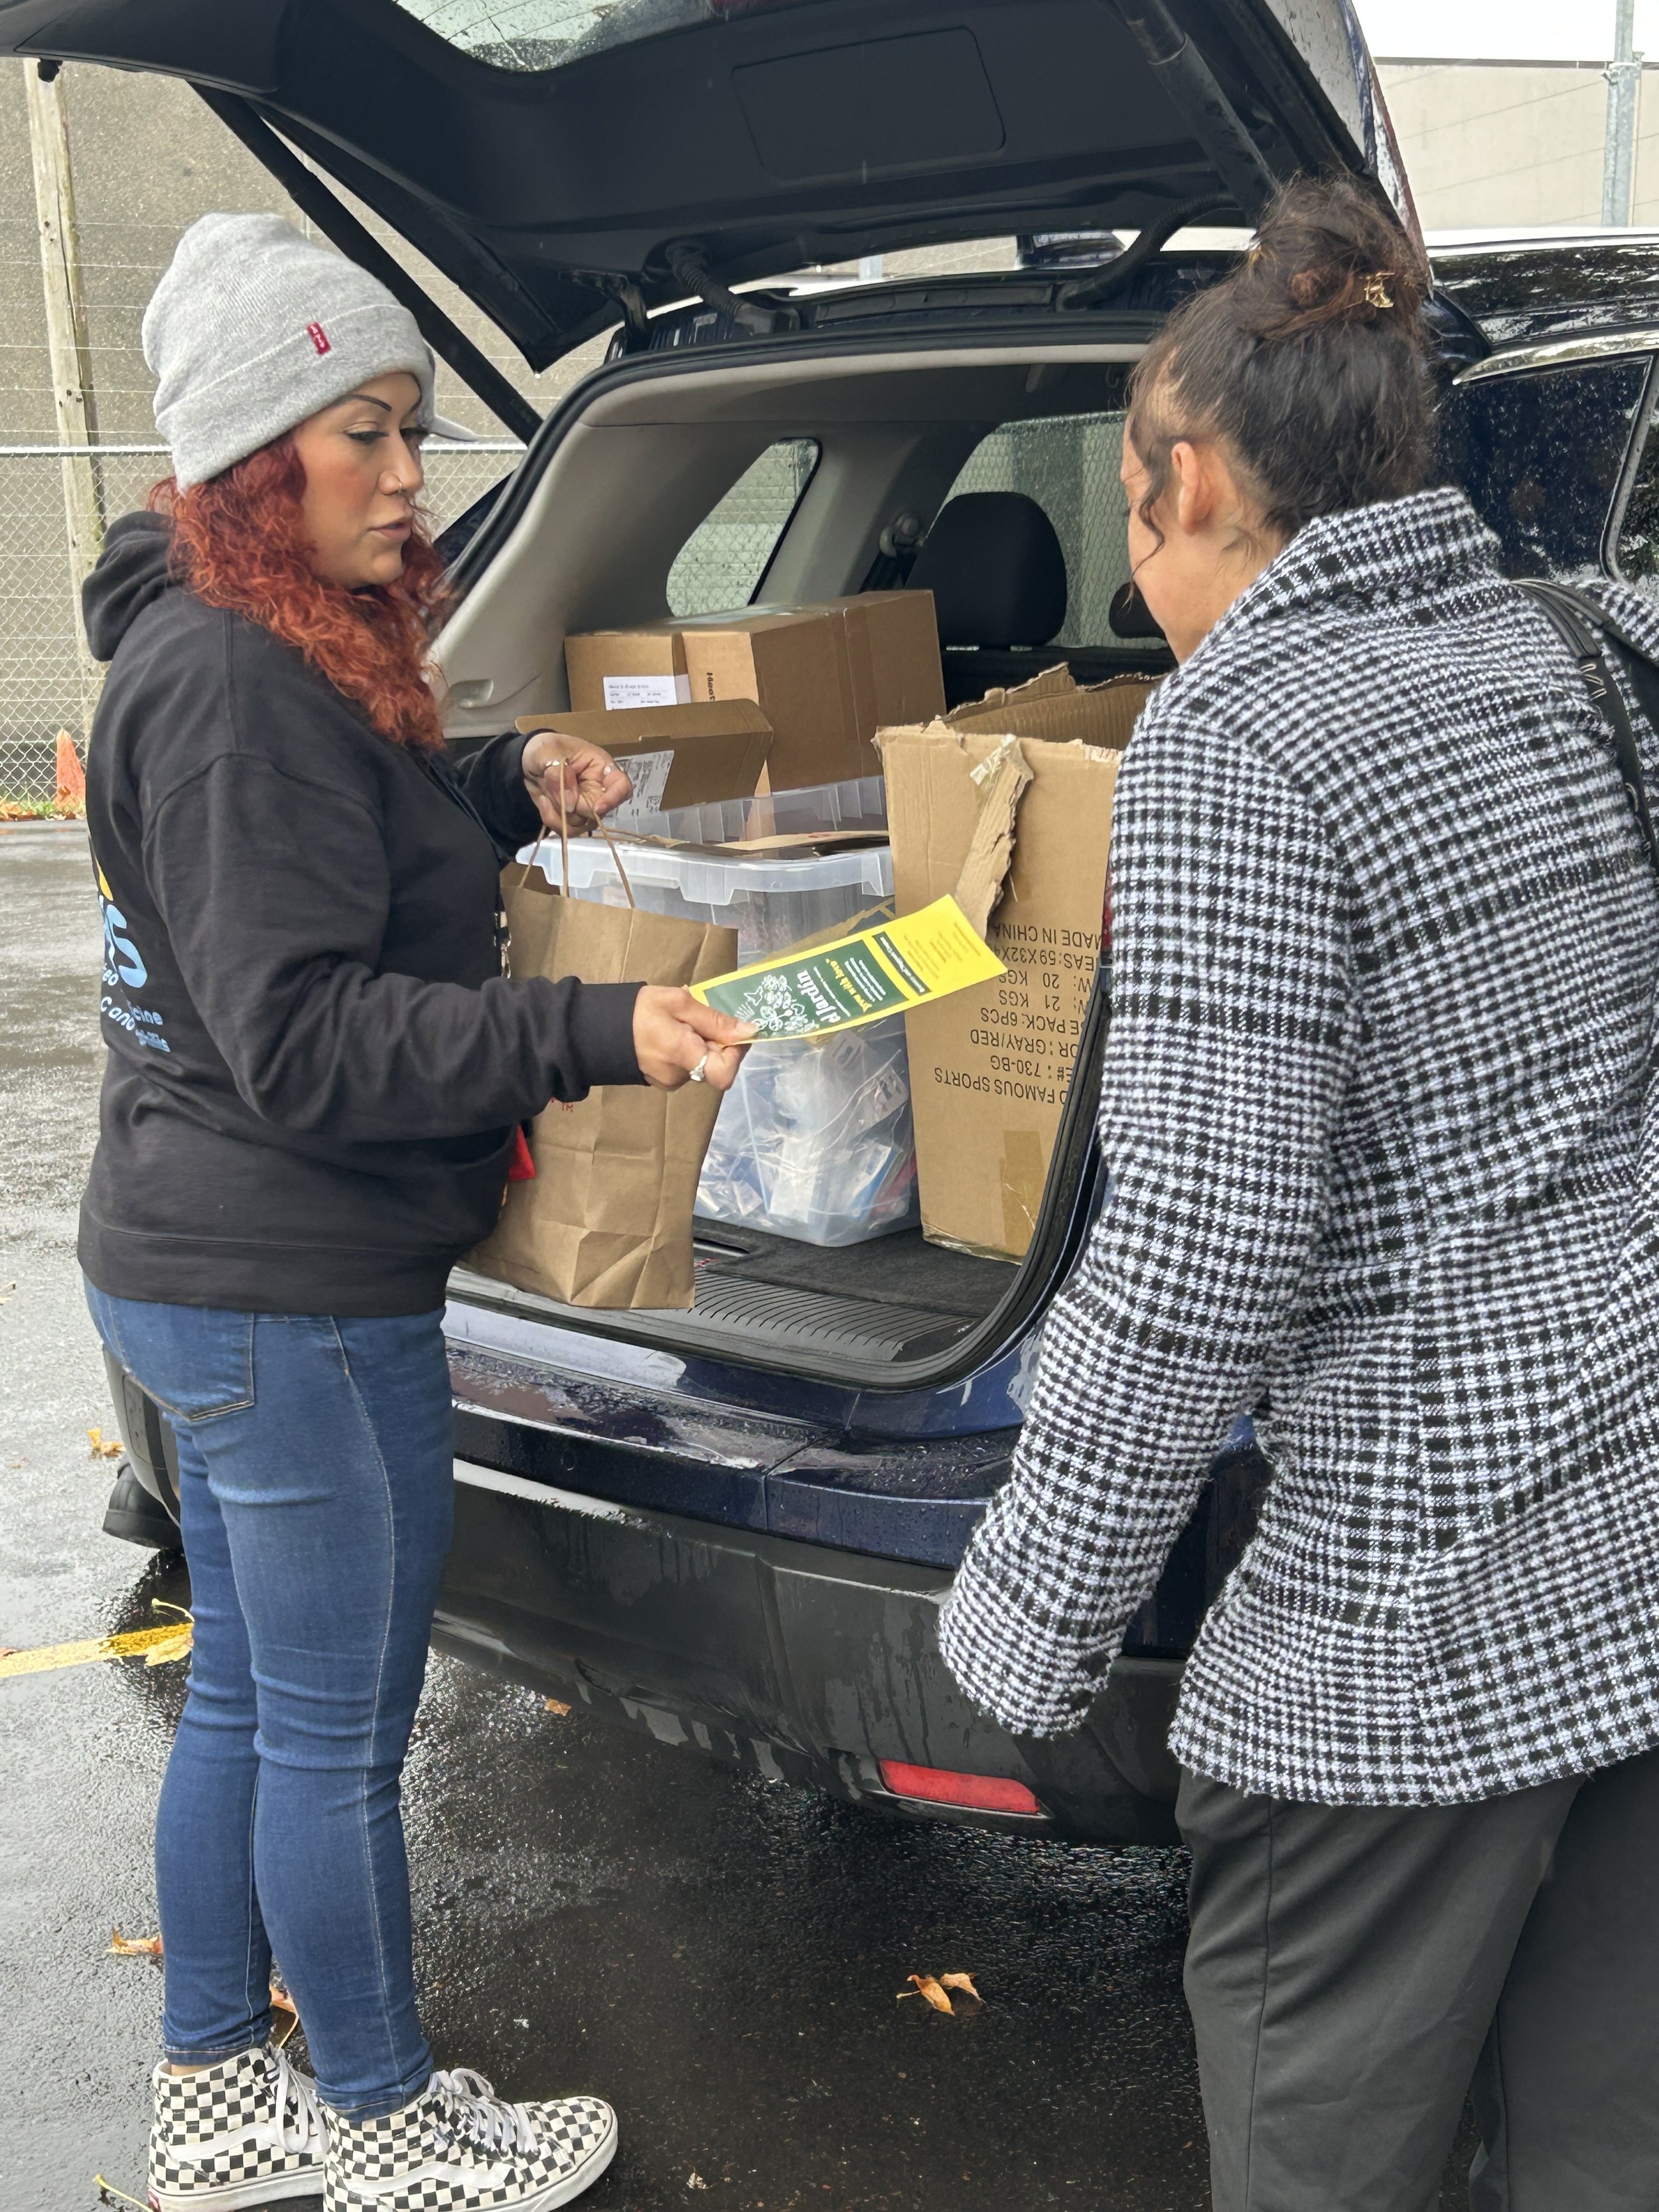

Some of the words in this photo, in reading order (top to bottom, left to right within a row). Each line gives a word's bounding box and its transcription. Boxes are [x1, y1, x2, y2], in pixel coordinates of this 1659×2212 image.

[993, 922, 1038, 942] CHINA
[1043, 928, 1057, 945] IN
[1059, 953, 1099, 972] EAS:
[1043, 972, 1060, 990] 20
[999, 990, 1029, 1007] KGS
[1045, 995, 1060, 1011] 21
[981, 1007, 1017, 1026] 6PCS
[991, 1055, 1041, 1077] 730-BG
[934, 1067, 990, 1092] SPORTS
[994, 1079, 1055, 1104] FAMOUS
